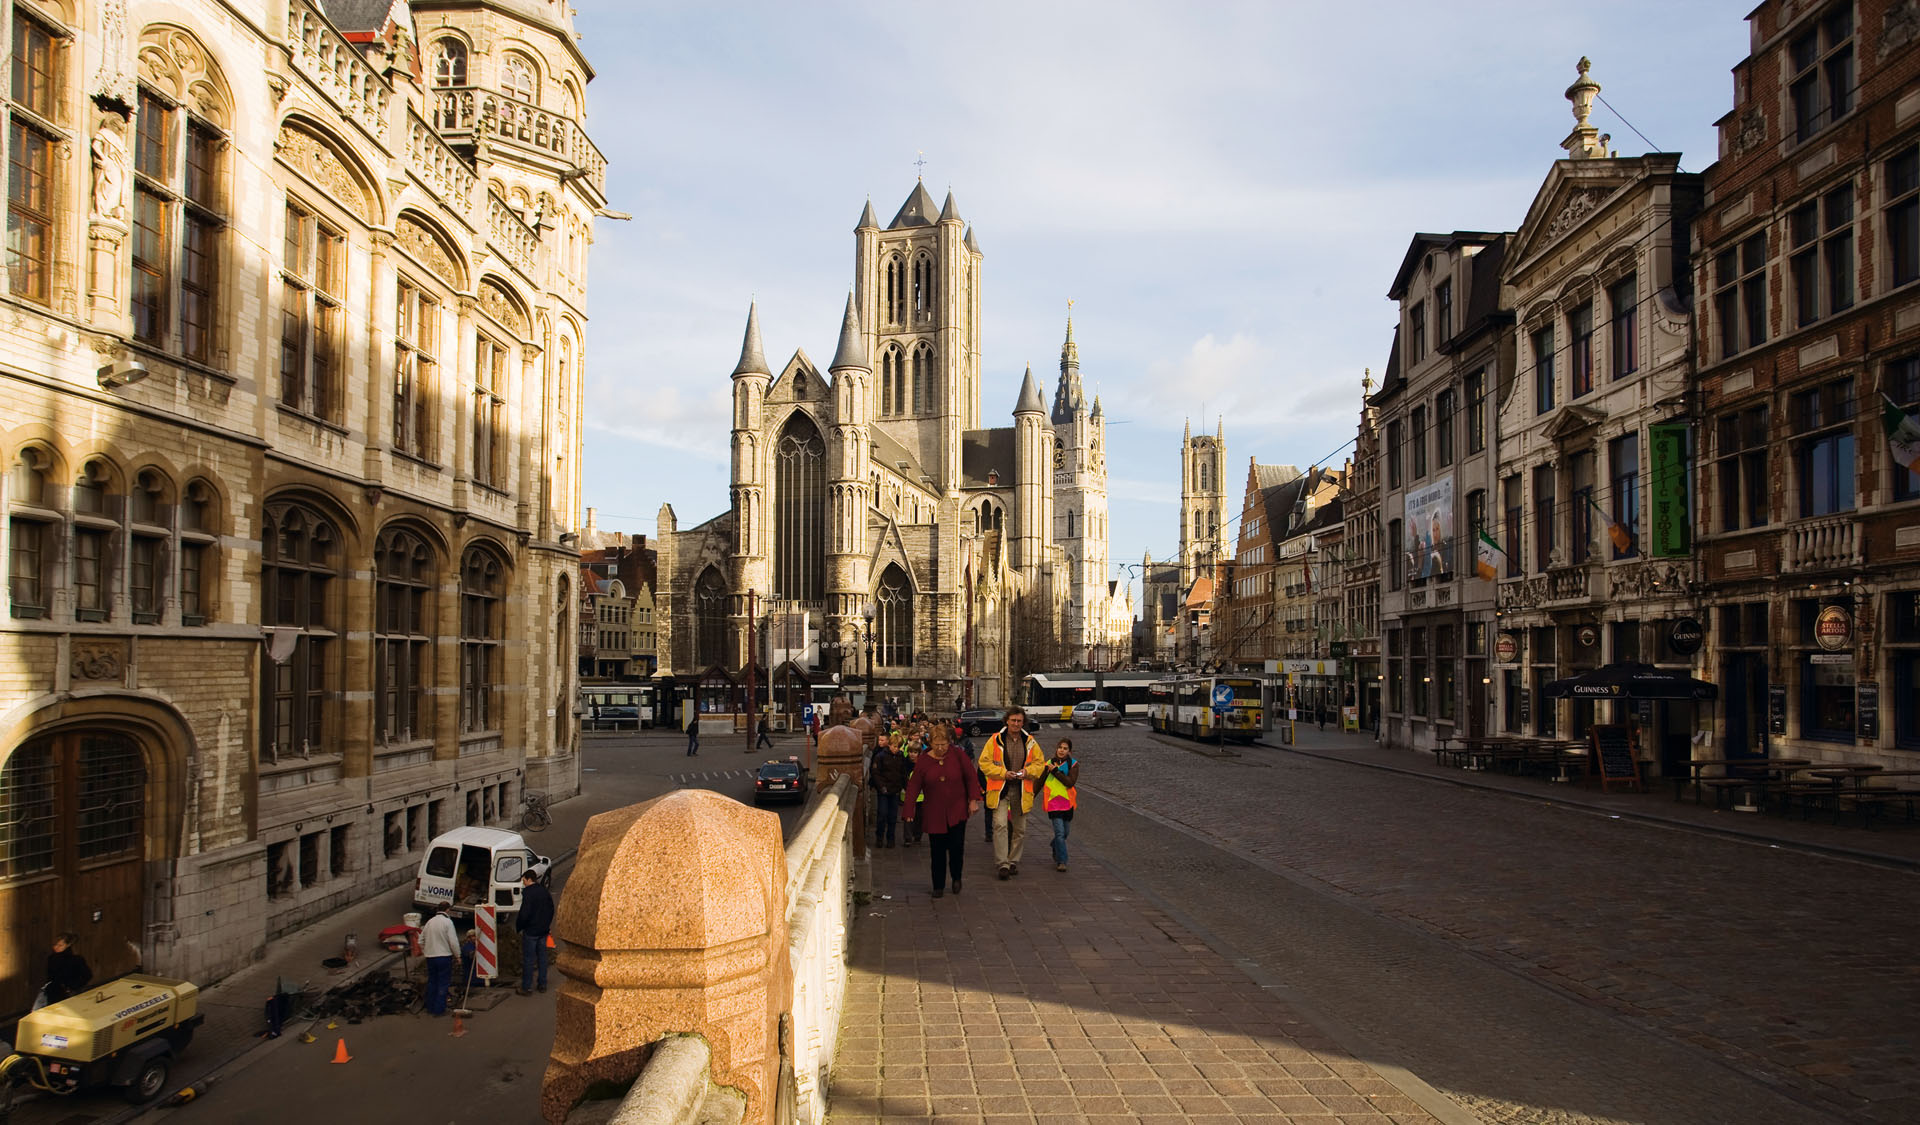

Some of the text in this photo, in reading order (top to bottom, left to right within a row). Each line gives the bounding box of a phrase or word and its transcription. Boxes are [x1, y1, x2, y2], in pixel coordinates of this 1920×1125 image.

[1574, 684, 1609, 694] GUINNESS
[804, 707, 812, 719] P
[428, 886, 453, 897] VORM
[115, 993, 169, 1019] VORMEZEELE
